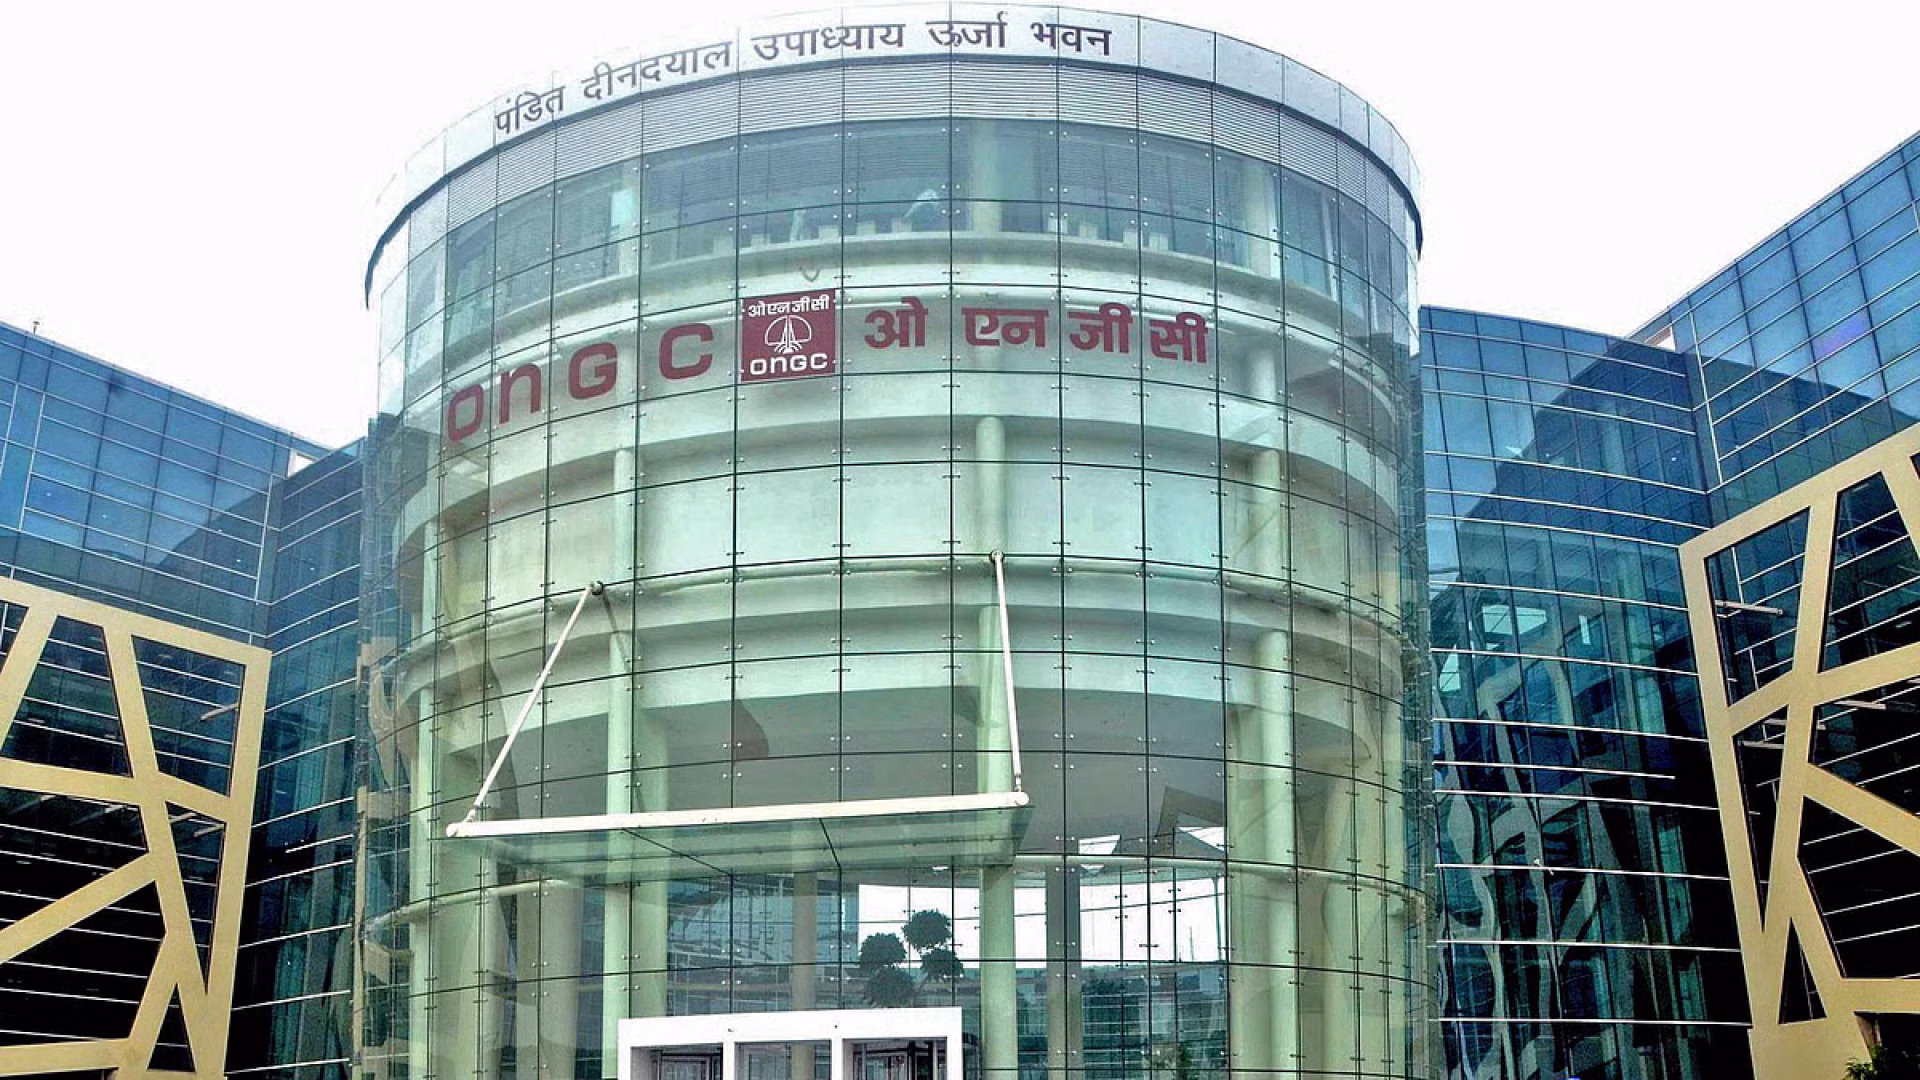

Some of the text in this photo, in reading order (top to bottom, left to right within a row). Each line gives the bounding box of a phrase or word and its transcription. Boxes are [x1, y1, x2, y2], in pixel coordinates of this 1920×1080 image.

[495, 11, 1112, 134] पंडित दीनदयाल उपाध्याय ऊर्जा भवन
